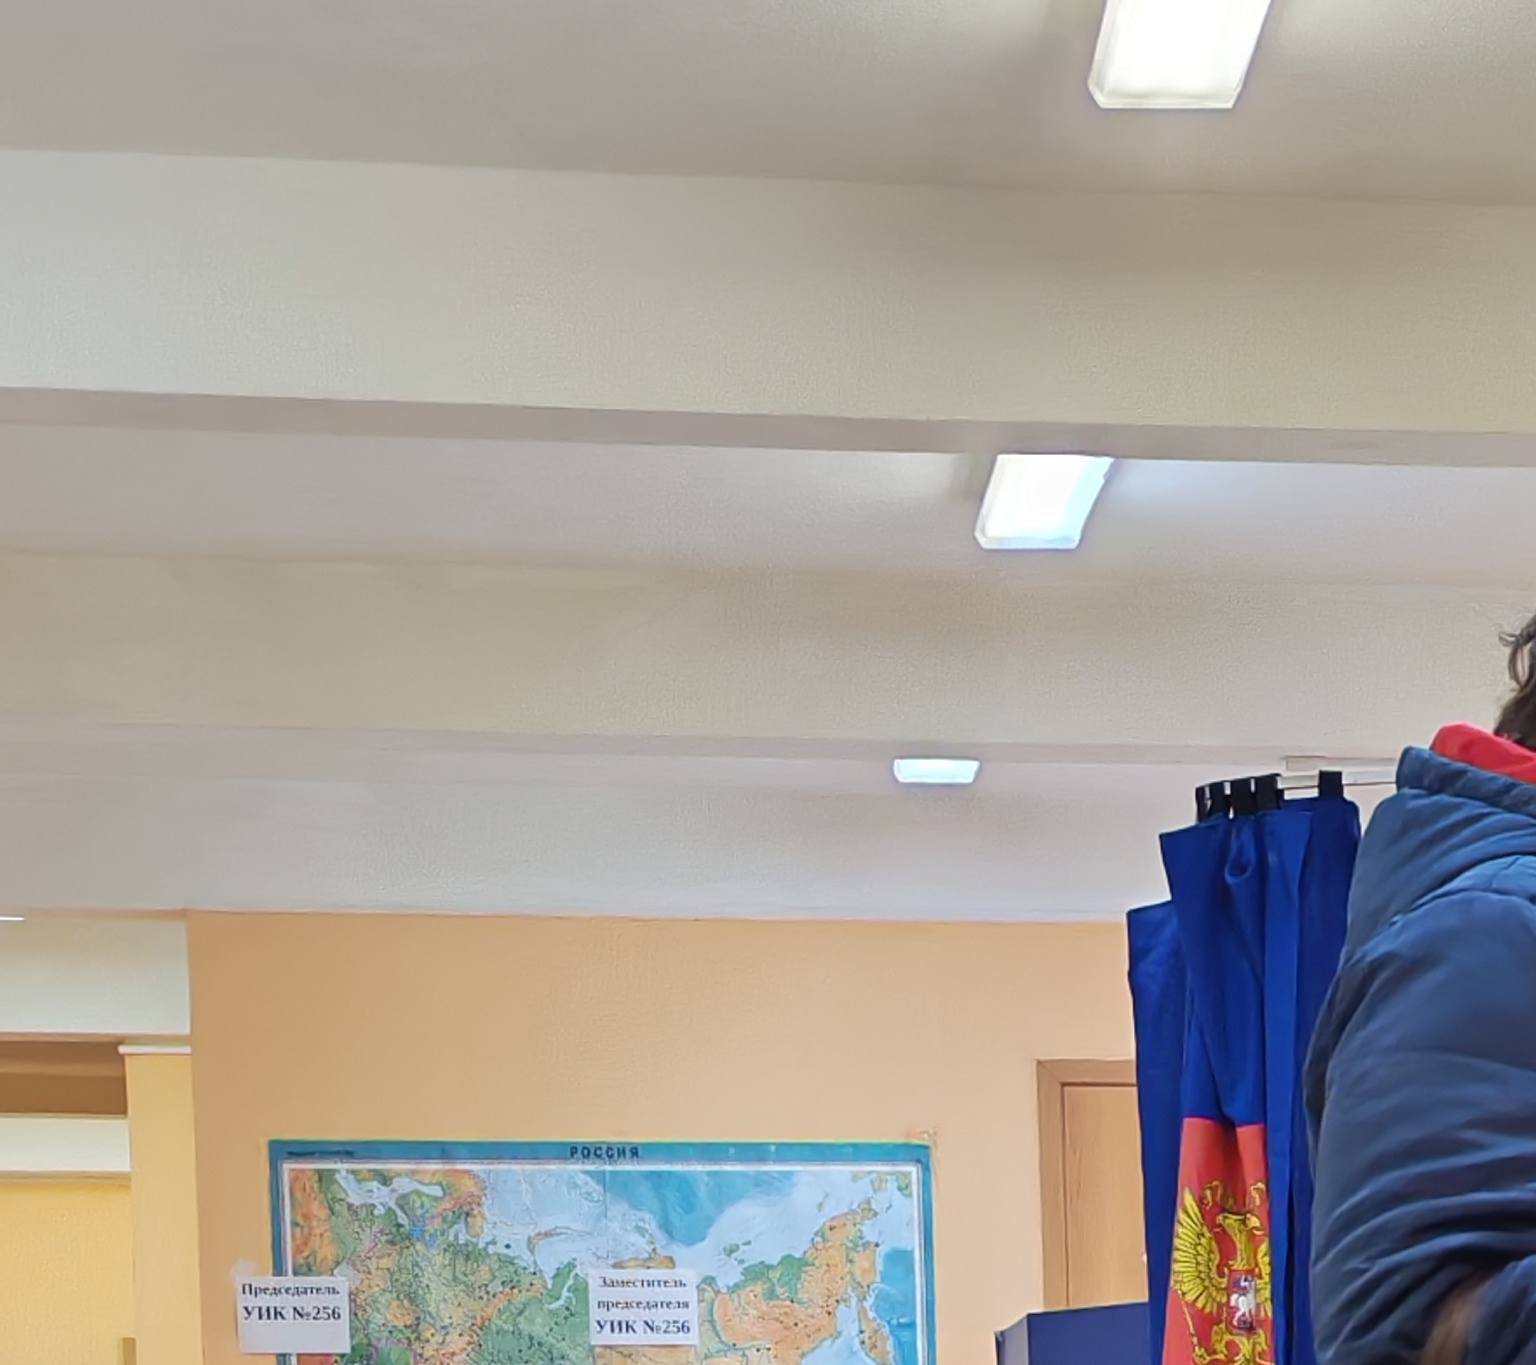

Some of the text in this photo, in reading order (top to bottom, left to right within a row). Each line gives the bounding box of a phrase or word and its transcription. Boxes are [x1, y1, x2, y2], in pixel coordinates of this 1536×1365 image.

[569, 1145, 640, 1159] РОССИЯ
[598, 1275, 687, 1288] Заместитель
[241, 1282, 341, 1298] Председатель
[243, 1305, 342, 1321] УИК №256
[596, 1299, 690, 1312] председателя
[595, 1319, 691, 1335] УИК №256
